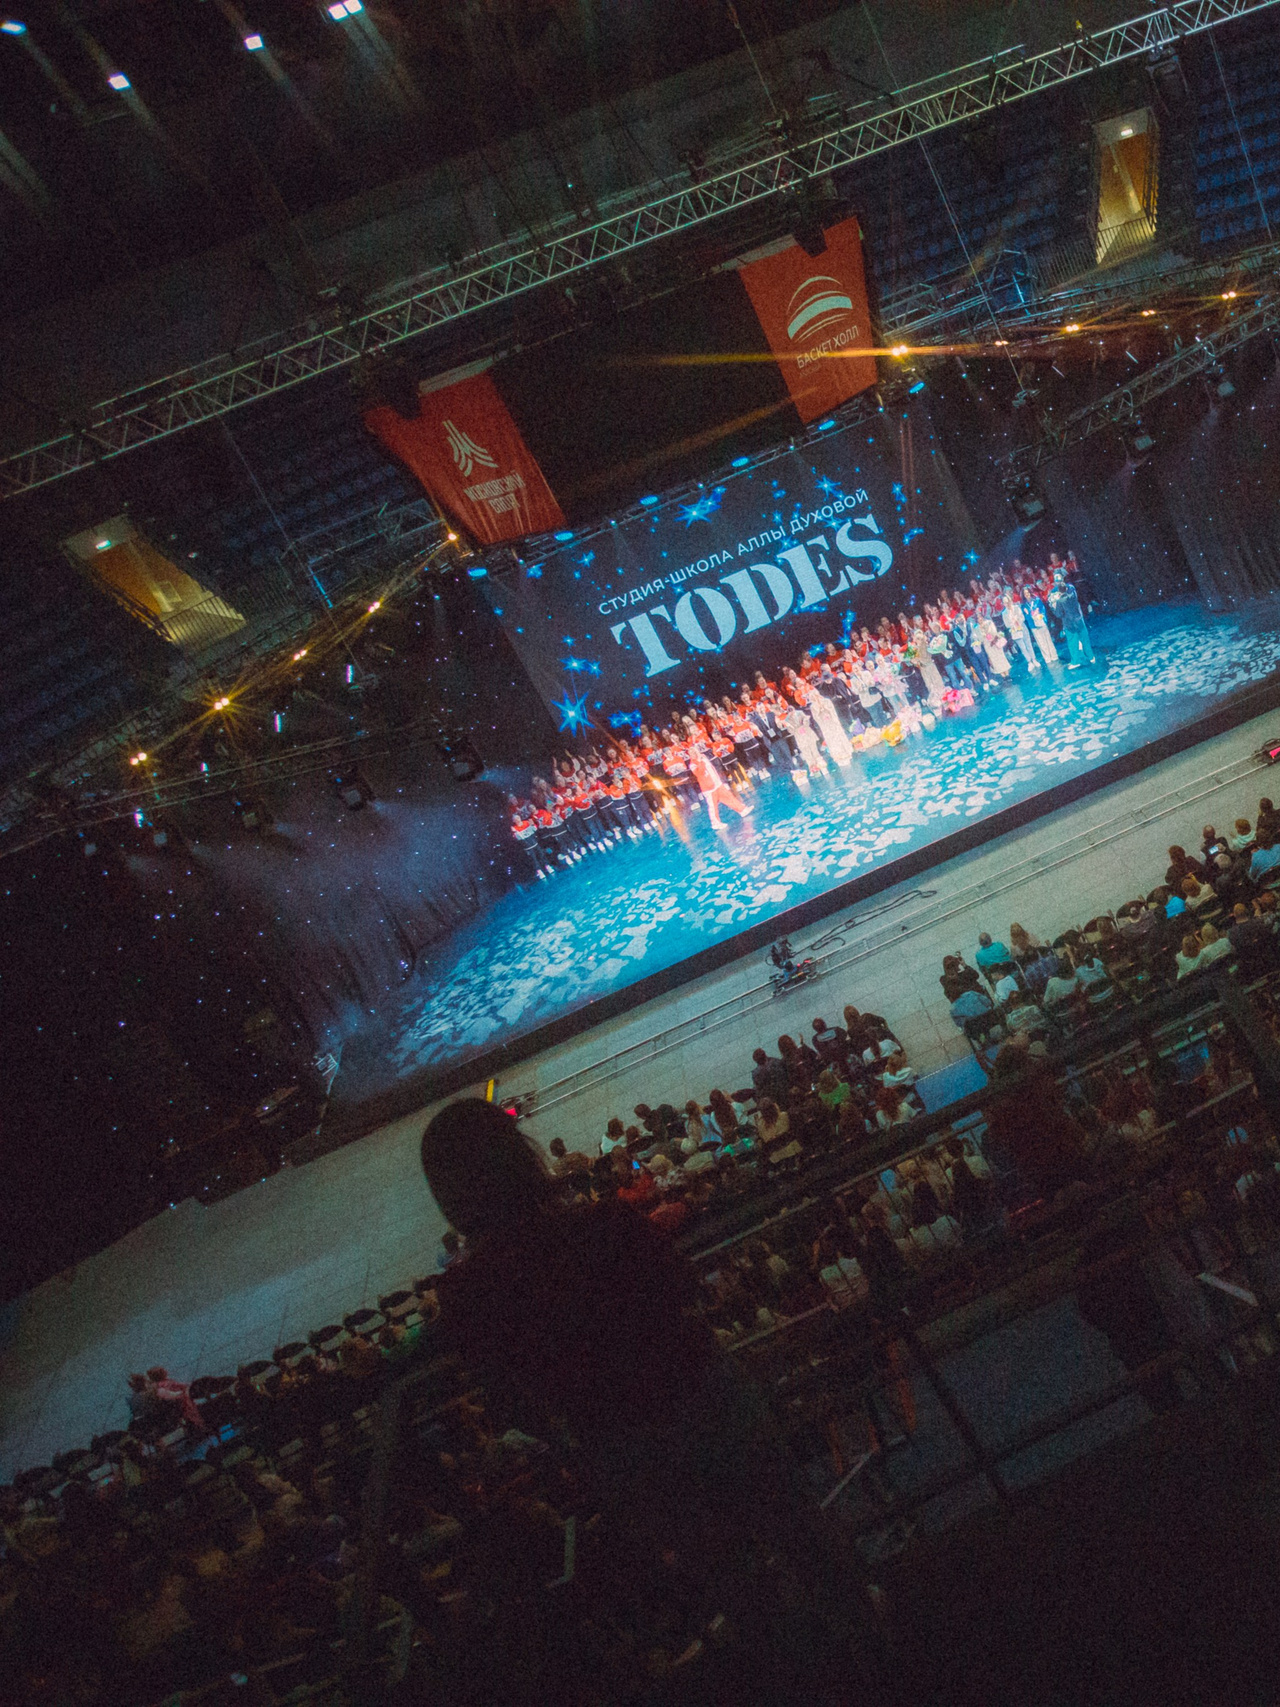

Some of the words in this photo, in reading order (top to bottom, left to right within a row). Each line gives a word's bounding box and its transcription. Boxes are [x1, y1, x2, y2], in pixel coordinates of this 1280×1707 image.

[796, 339, 833, 369] БАСКЕТ
[833, 325, 860, 346] ХОЛЛ
[598, 549, 734, 616] СТУДИЯ-ШКОЛА
[736, 526, 787, 556] АЛЛЫ
[789, 487, 869, 536] ДУХОВОЙ
[609, 513, 894, 678] TODES
